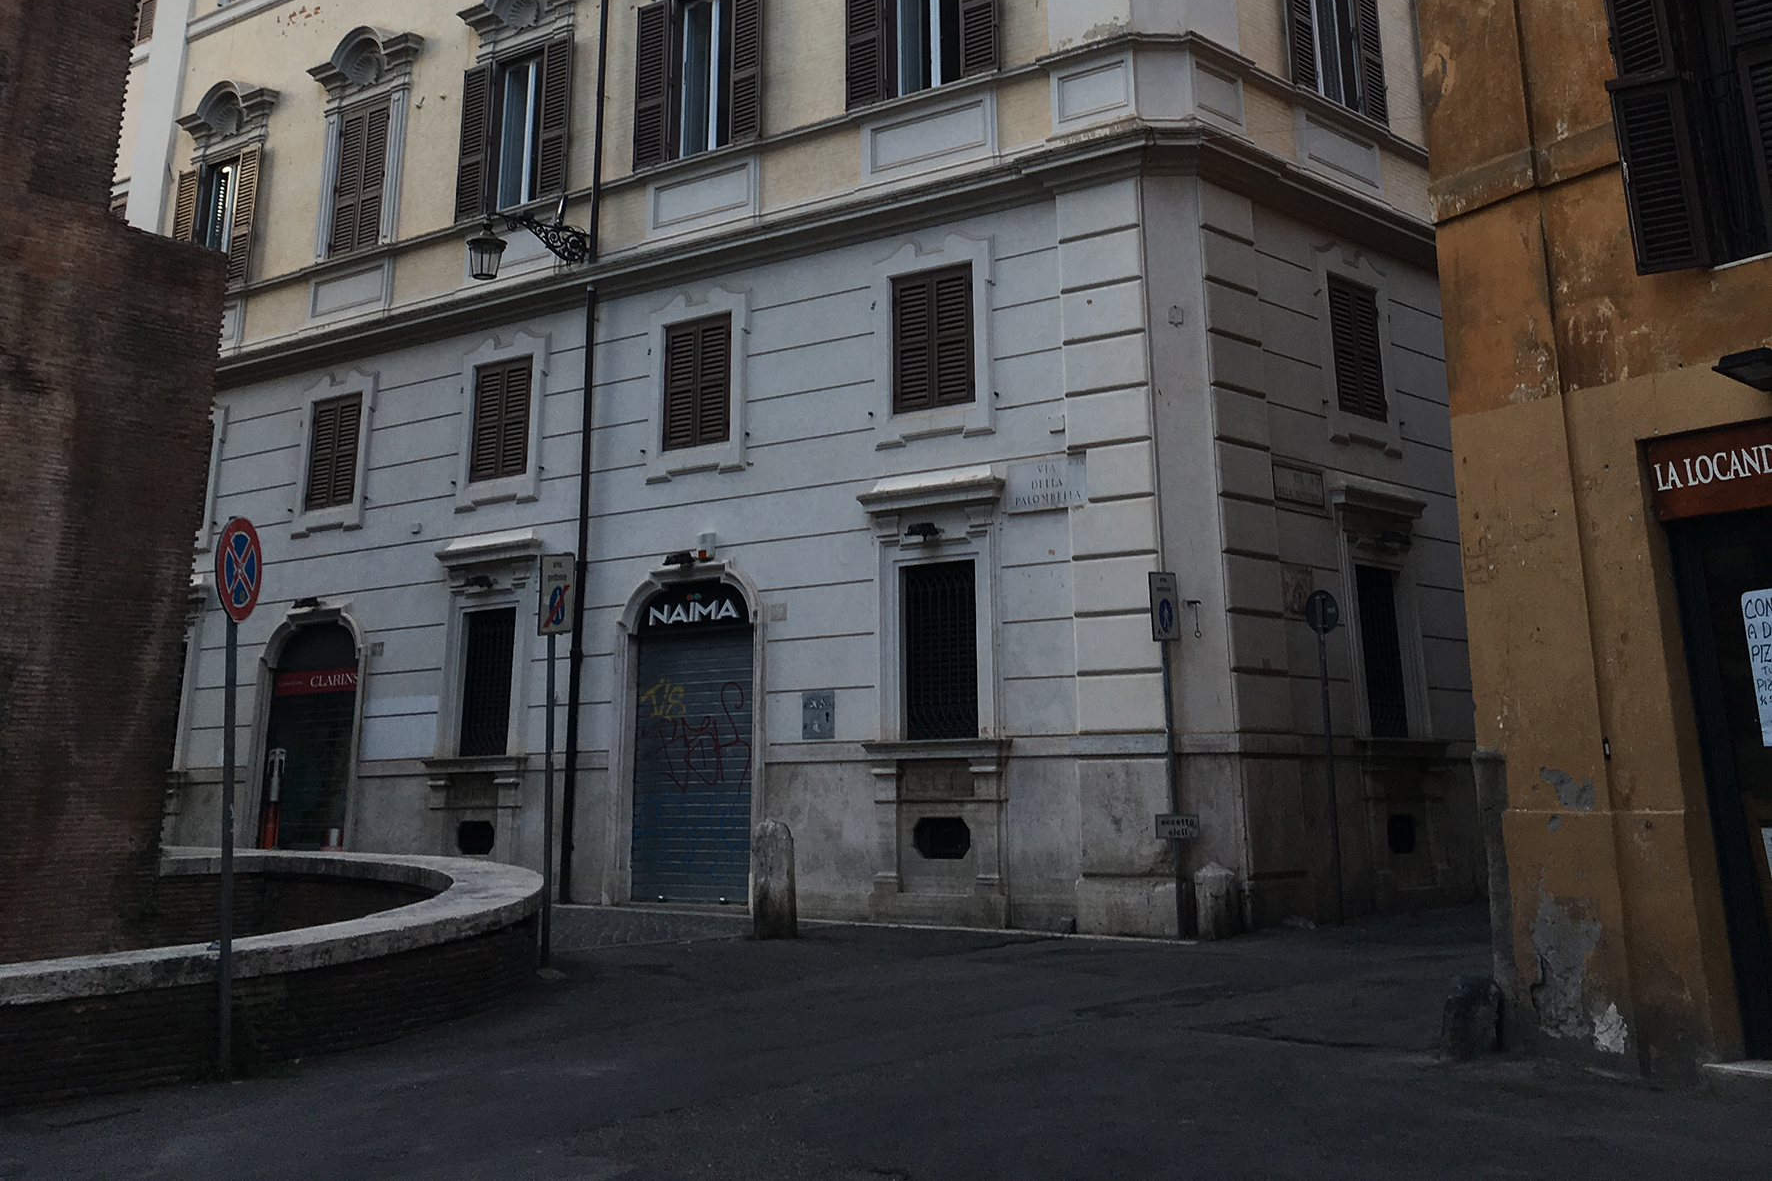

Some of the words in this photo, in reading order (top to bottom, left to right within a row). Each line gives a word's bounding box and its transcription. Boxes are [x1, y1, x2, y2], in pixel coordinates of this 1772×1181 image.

[1037, 463, 1056, 474] VIA
[1653, 461, 1683, 492] LA
[1683, 444, 1772, 487] LOCAND
[1031, 478, 1063, 490] DELLA
[1015, 490, 1083, 507] PALOMBELLA
[1747, 623, 1758, 640] A
[309, 672, 357, 689] CLARINS
